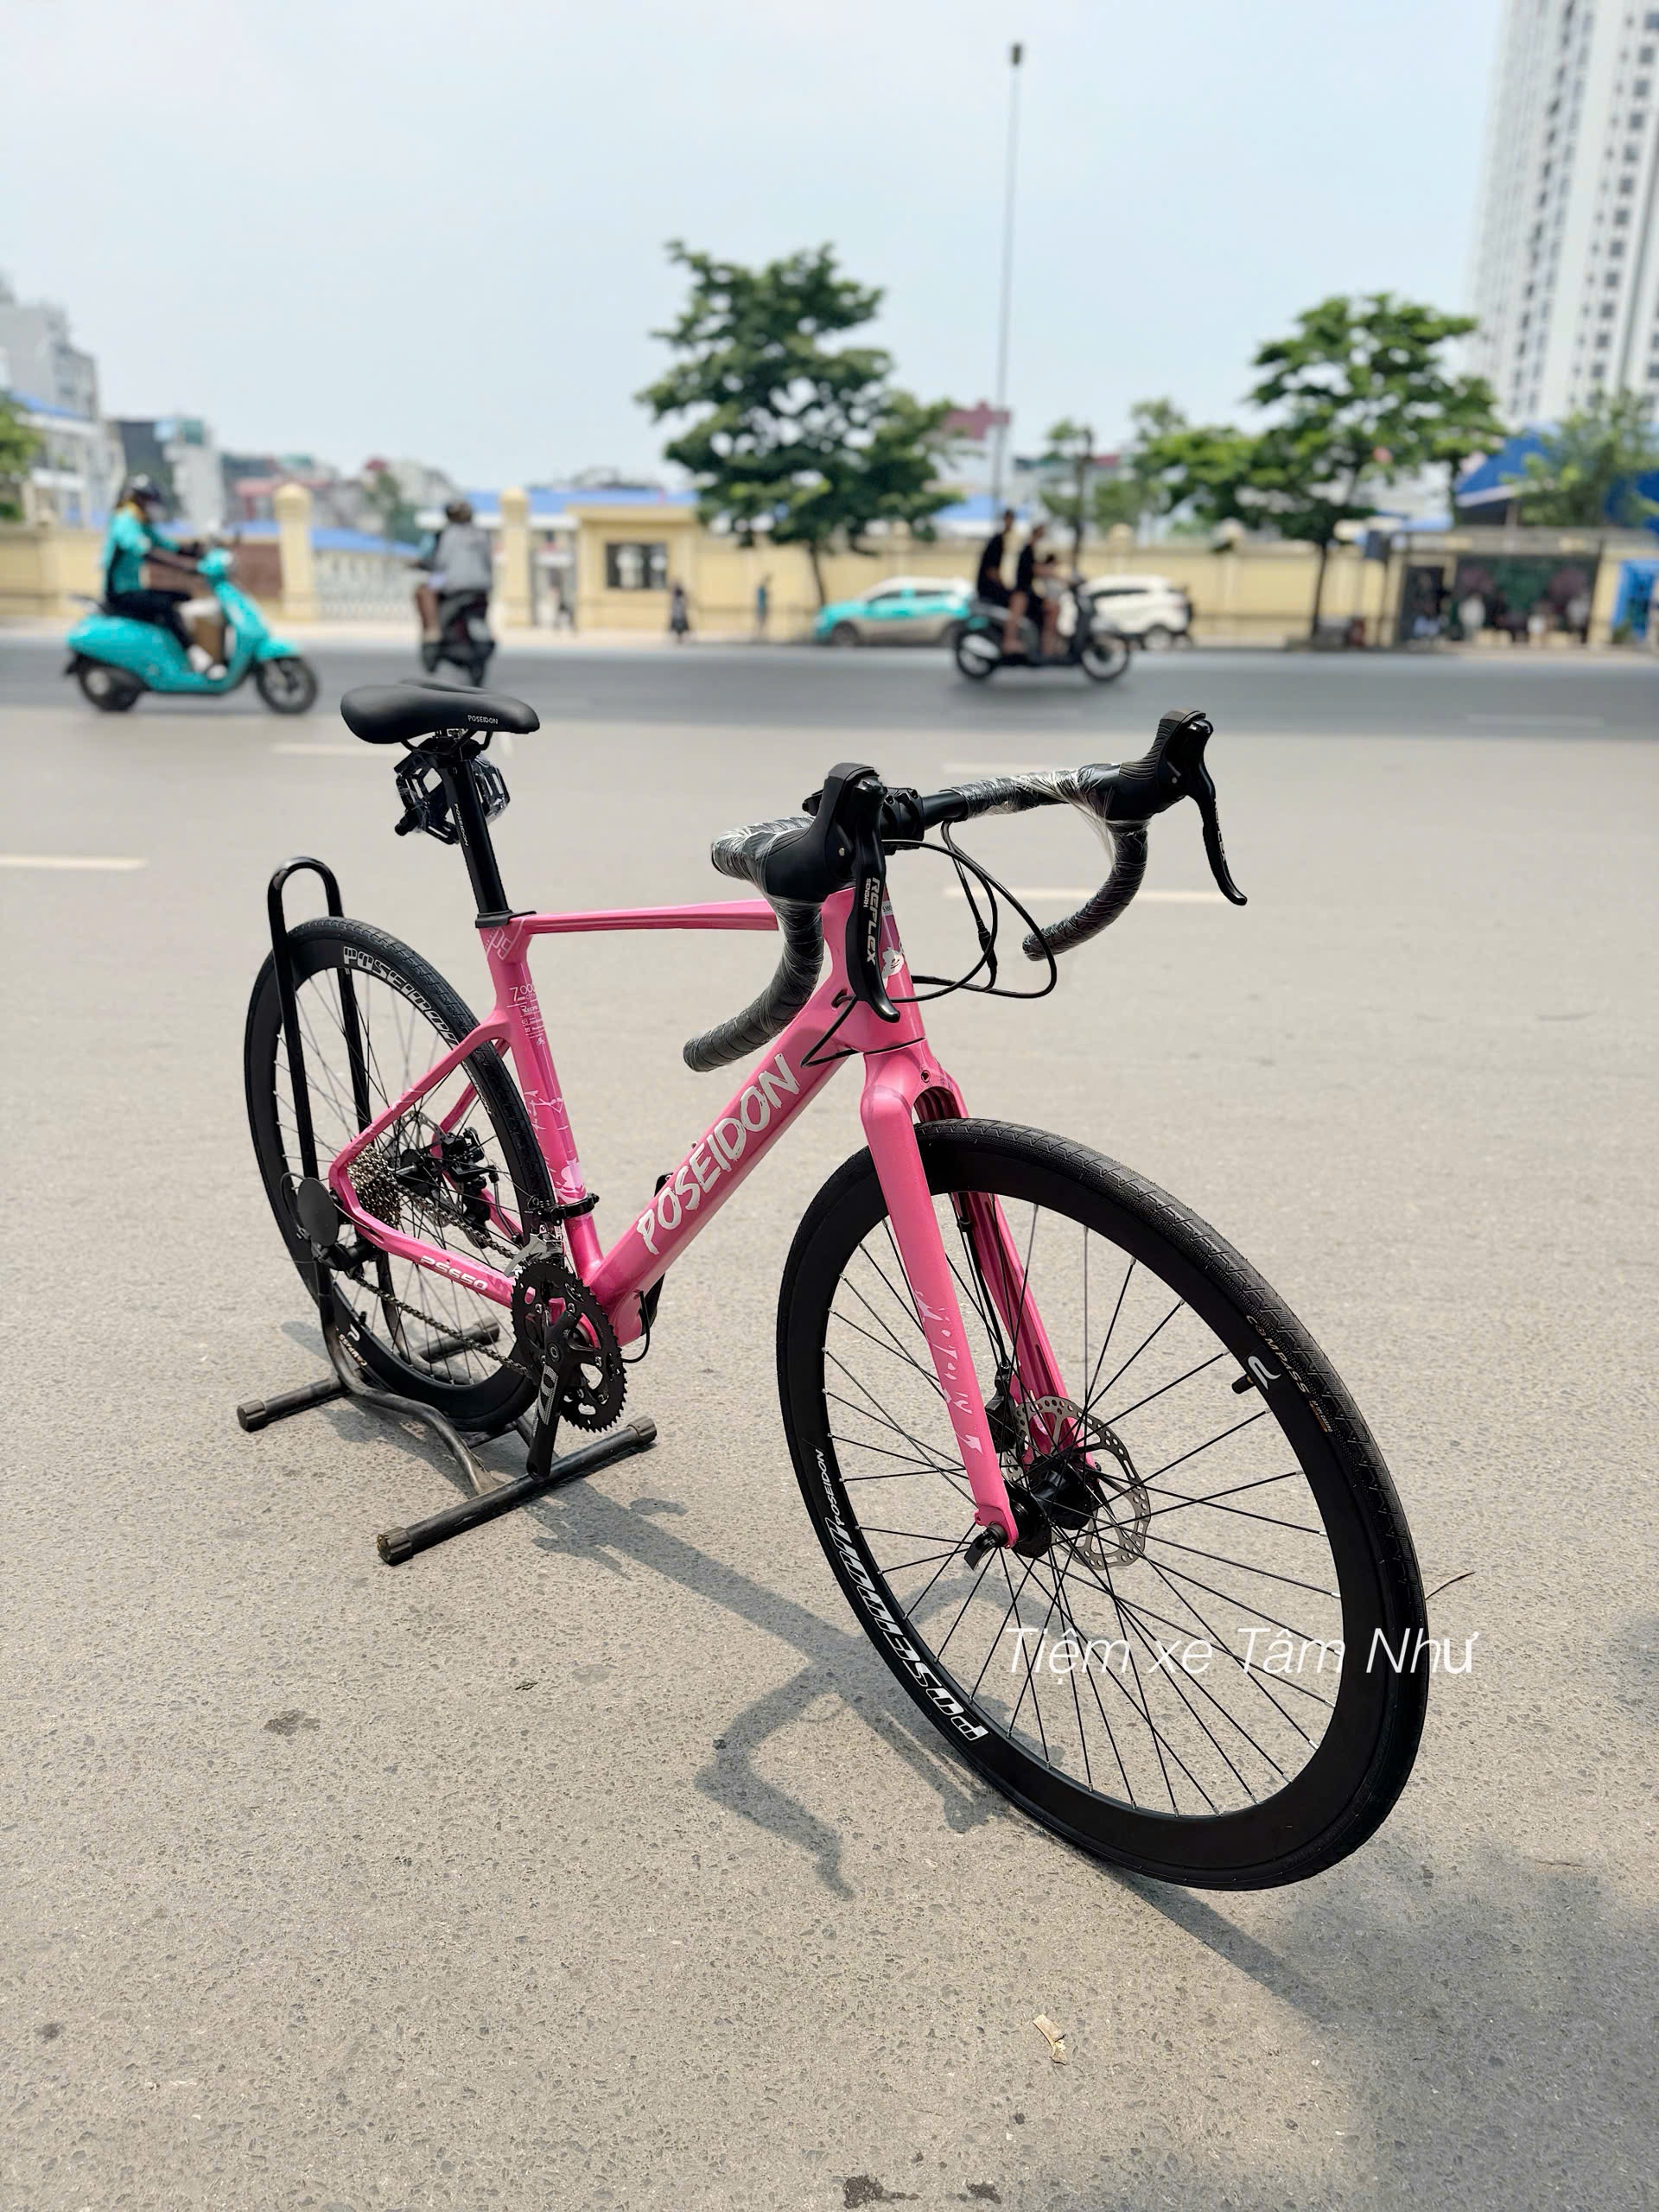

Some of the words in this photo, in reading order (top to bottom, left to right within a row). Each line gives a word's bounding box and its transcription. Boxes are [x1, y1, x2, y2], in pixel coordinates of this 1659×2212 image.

[467, 715, 499, 725] POSEIDON
[454, 803, 469, 847] POSEIDON
[863, 878, 872, 907] SENSAH
[867, 877, 880, 966] REFLEX
[636, 1053, 800, 1255] POSEIDON
[1246, 1315, 1311, 1394] COMPASS
[815, 1448, 845, 1526] POSEIDON
[825, 1516, 988, 1741] POSEIDON
